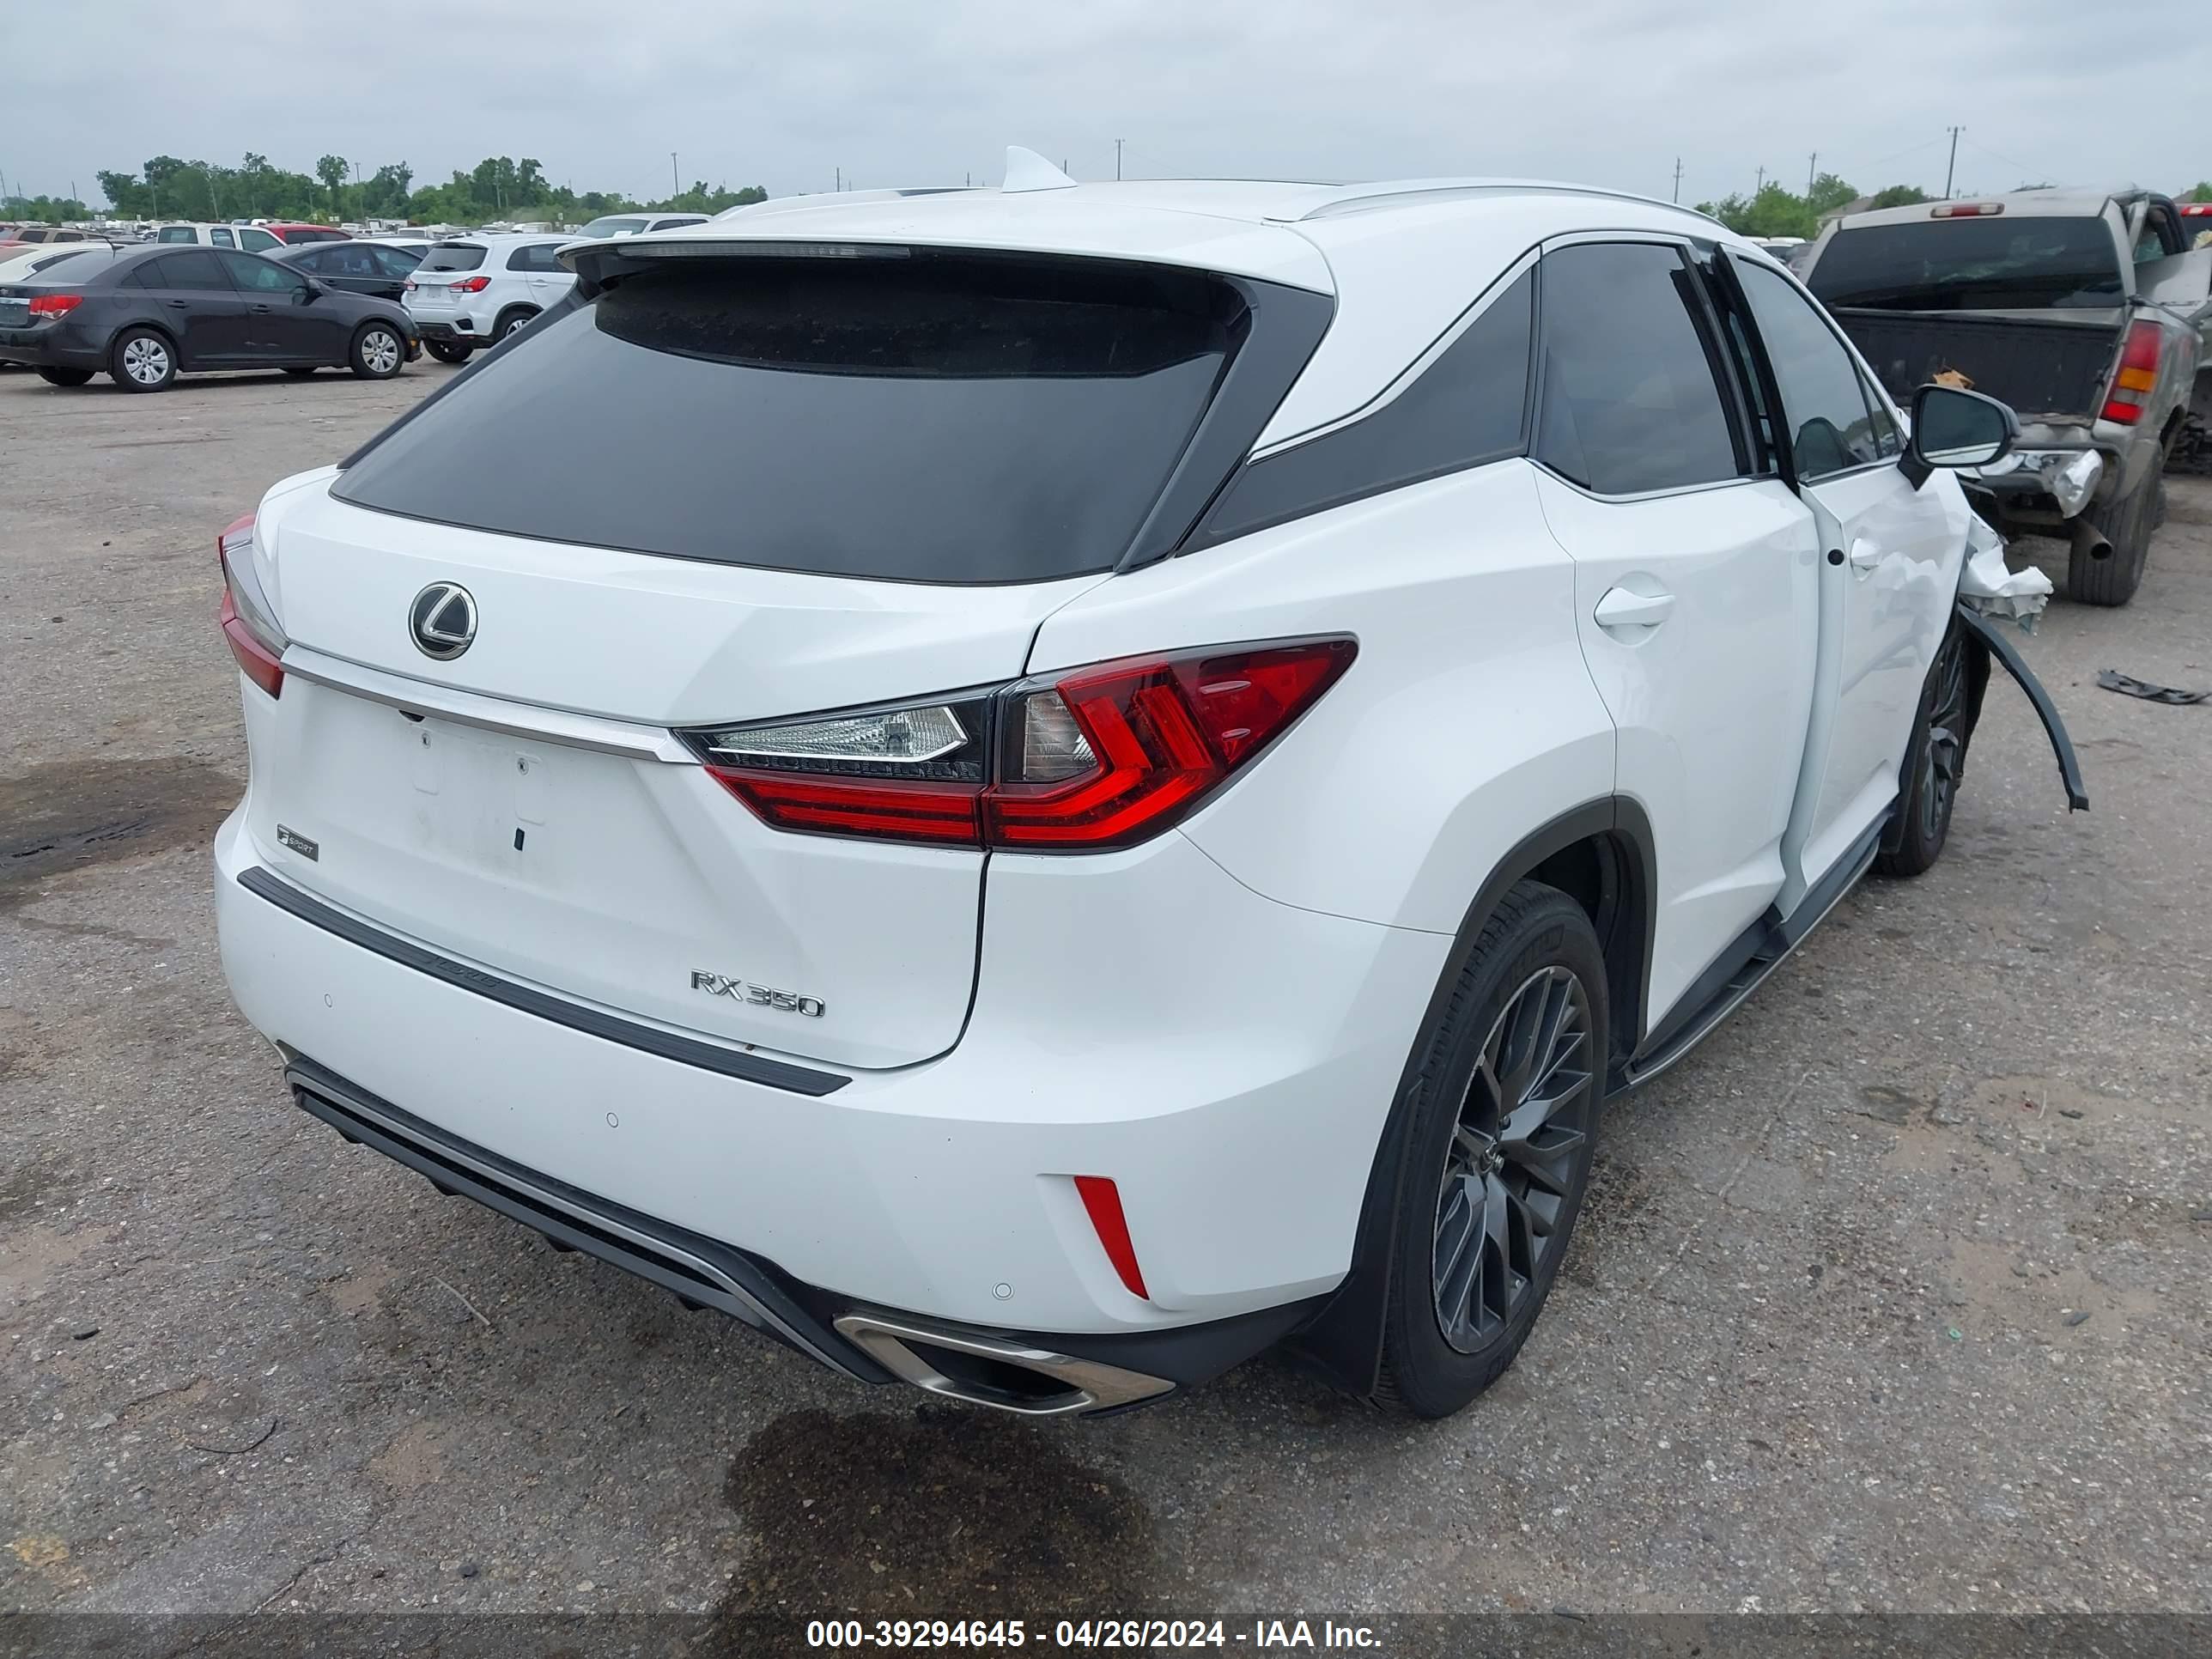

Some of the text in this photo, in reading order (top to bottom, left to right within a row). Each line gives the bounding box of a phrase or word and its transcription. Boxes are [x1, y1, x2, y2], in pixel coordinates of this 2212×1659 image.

[289, 836, 313, 854] SPORT
[435, 961, 502, 988] LEXUS
[690, 968, 826, 1018] RX 350
